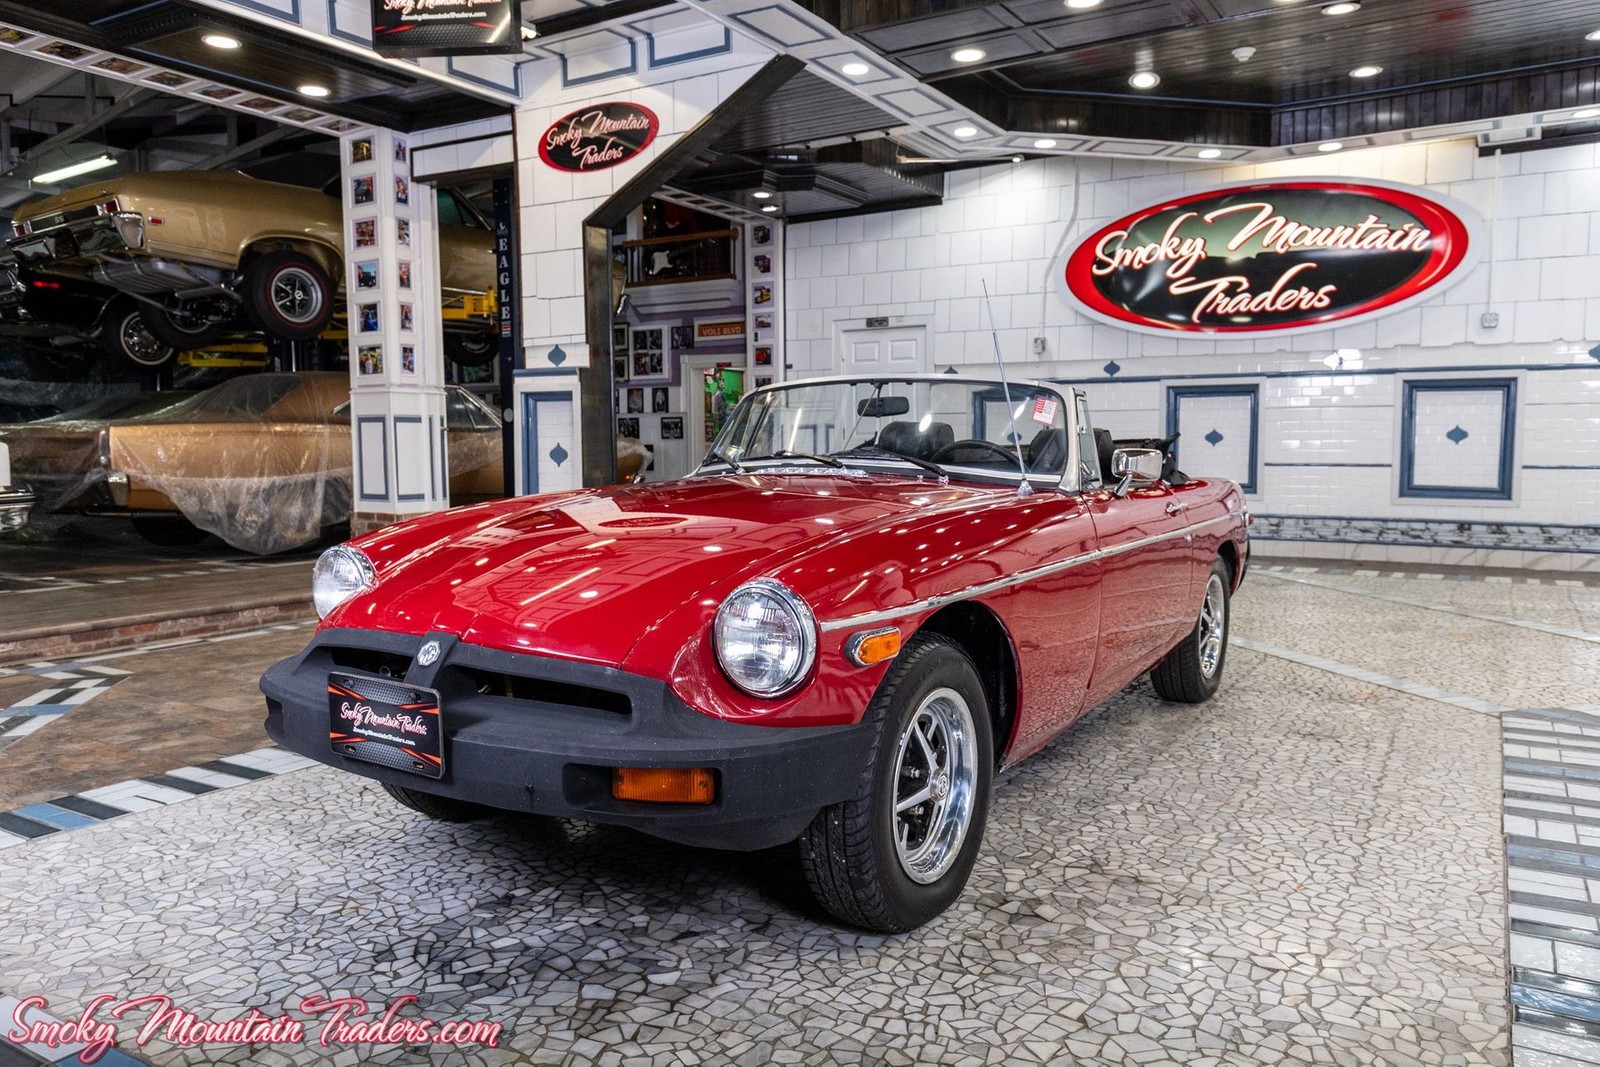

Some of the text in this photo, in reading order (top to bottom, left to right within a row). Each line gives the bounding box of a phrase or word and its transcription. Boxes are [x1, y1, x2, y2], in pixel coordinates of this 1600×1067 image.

[546, 110, 650, 150] Smoky Mountain
[572, 137, 624, 169] Traders
[1092, 202, 1433, 279] Smoky Mountain
[499, 238, 510, 320] EAGLE
[1169, 262, 1338, 324] Traders
[702, 326, 742, 336] VOLS BLVD
[341, 702, 428, 736] Smoky Mountain Traders
